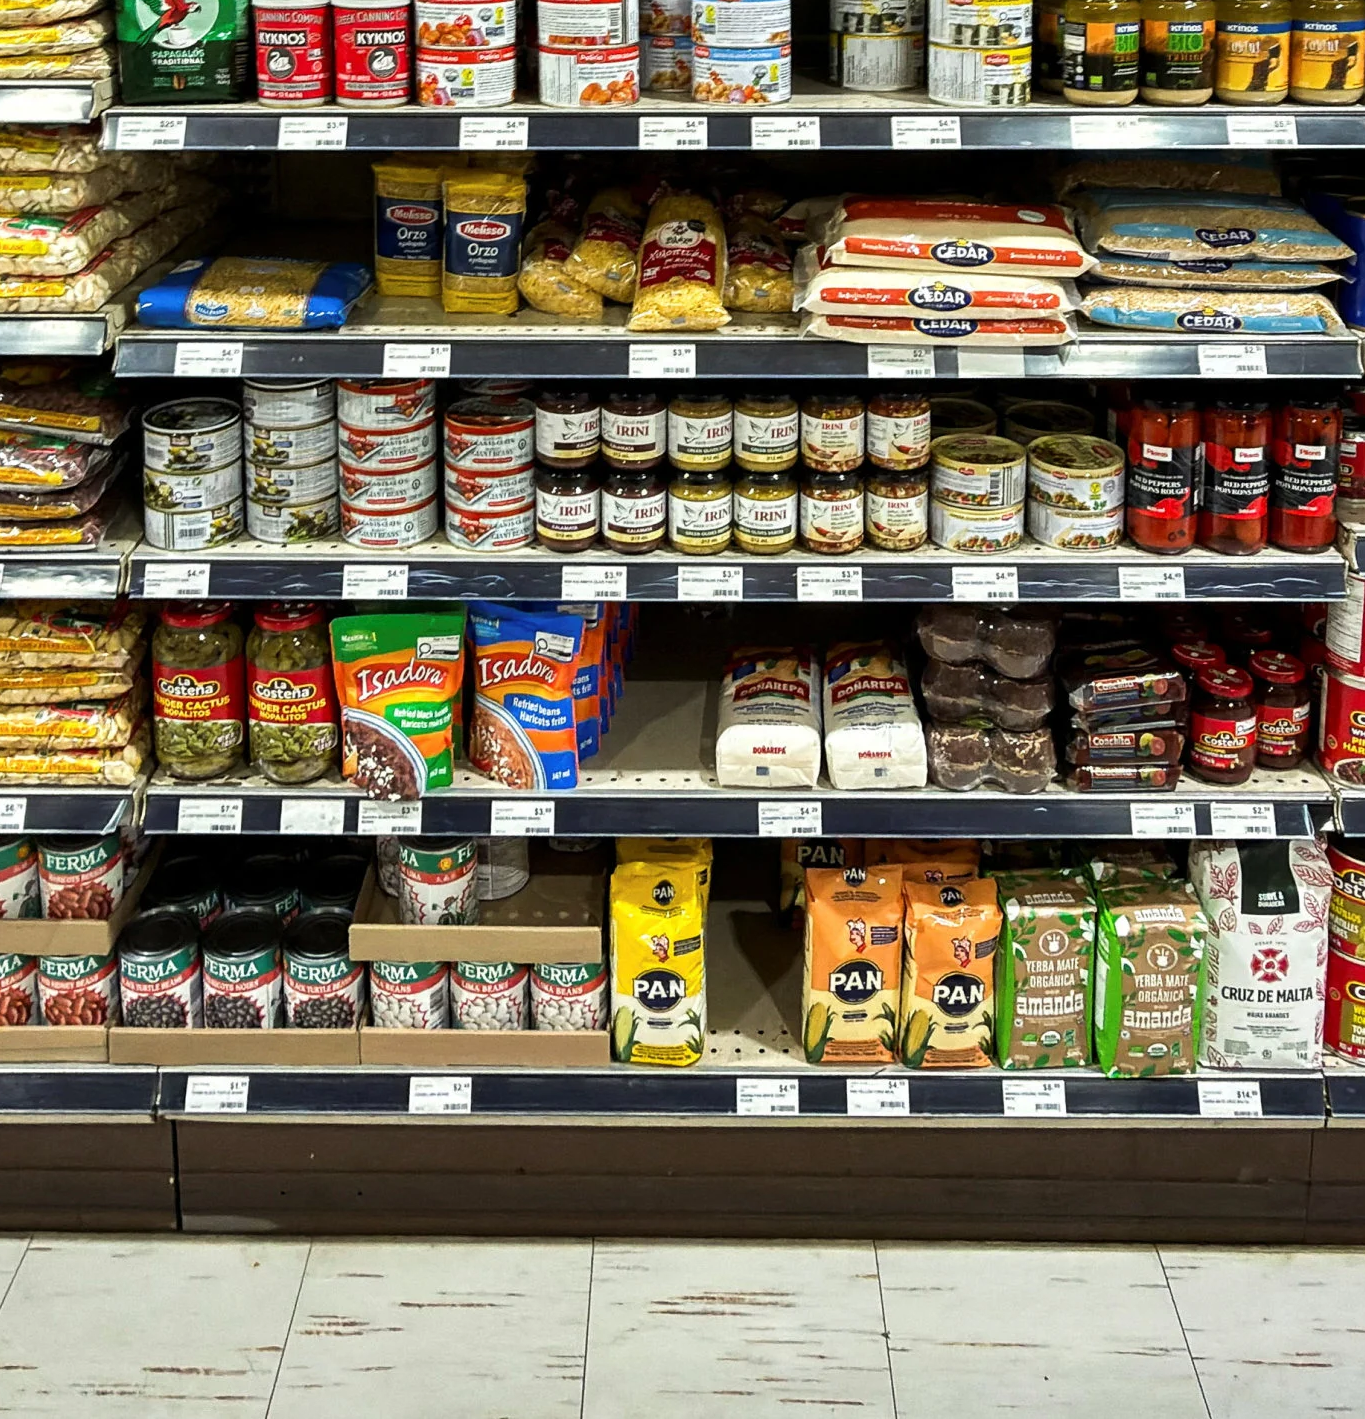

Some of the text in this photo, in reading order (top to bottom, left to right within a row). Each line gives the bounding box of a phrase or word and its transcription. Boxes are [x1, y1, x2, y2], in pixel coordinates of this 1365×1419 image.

[259, 31, 306, 44] KYKNOS
[356, 31, 405, 44] KYKNOS
[1169, 34, 1202, 52] BIO
[397, 228, 427, 240] Orzo
[463, 223, 504, 235] Melissa
[1201, 231, 1250, 241] CEDAR
[467, 243, 498, 257] Orzo
[937, 246, 987, 259] CEDAR
[914, 291, 965, 305] CEDAR
[1184, 316, 1234, 329] CEDAR
[616, 425, 649, 437] IRINI
[560, 504, 592, 515] IRINI
[887, 501, 909, 509] IRINI
[754, 510, 786, 521] IRINI
[478, 651, 556, 687] Isadora
[178, 677, 190, 686] La
[274, 681, 287, 689] La
[357, 657, 444, 701] Isadora
[160, 681, 214, 696] Costeña
[256, 685, 310, 699] Costeña
[838, 680, 903, 696] DOÑAREPA
[186, 696, 230, 711] CACTUS
[282, 698, 326, 713] CACTUS
[513, 698, 561, 716] Refried beans
[164, 708, 211, 717] NOPALITOS
[260, 711, 307, 721] NOPALITOS
[520, 711, 567, 727] Haricots frits
[1092, 736, 1132, 746] Conchita
[46, 847, 108, 872] FERMA
[797, 845, 845, 865] PAN
[121, 960, 177, 982] FERMA
[1025, 956, 1079, 973] YERBA MATE
[289, 961, 349, 983] FERMA
[461, 981, 508, 992] LIMA BEANS
[1030, 973, 1075, 988] ORGÁNICA
[1134, 973, 1190, 987] YERBA MATE
[554, 986, 583, 996] BEANS
[1221, 985, 1313, 1002] CRUZ DE MALTA
[1016, 991, 1084, 1016] amanda
[1123, 1004, 1191, 1029] amanda
